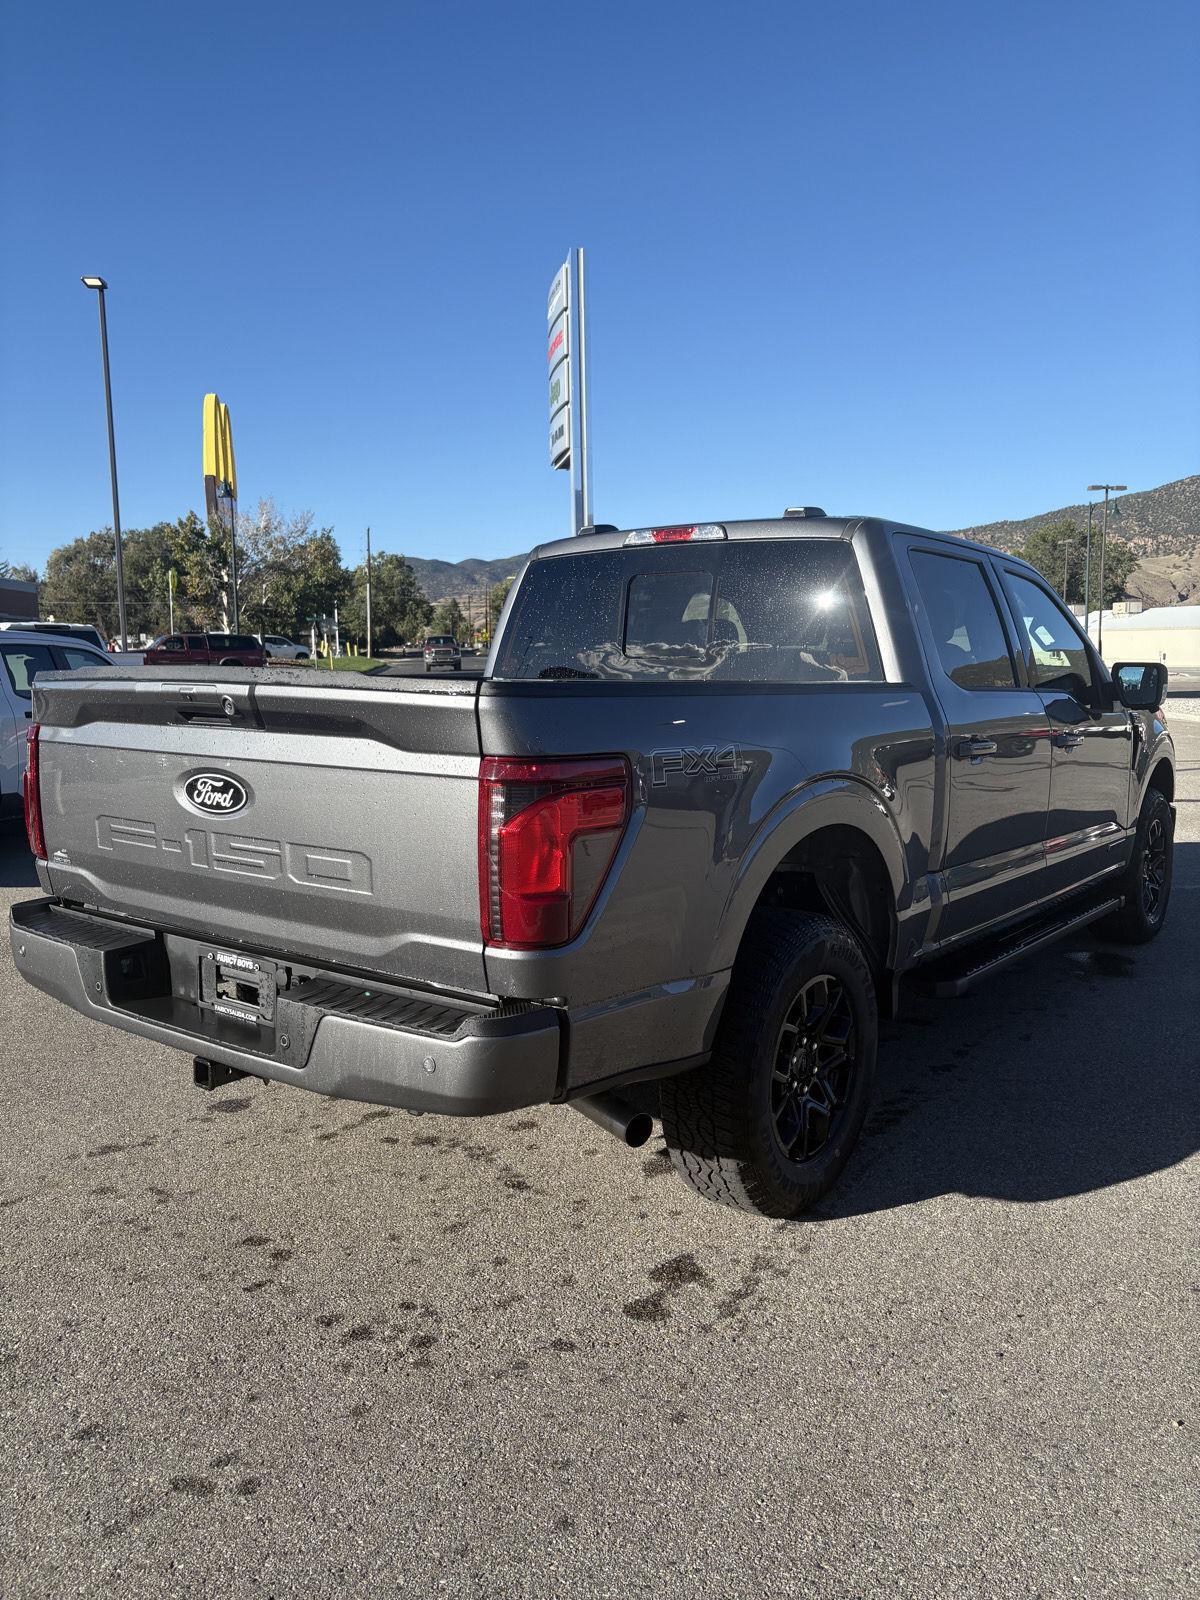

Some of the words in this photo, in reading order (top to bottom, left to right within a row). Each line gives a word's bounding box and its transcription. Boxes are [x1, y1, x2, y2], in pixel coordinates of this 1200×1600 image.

[649, 743, 744, 788] FX4
[193, 777, 235, 808] Ford
[95, 814, 374, 896] F-150
[236, 958, 254, 970] BOYS
